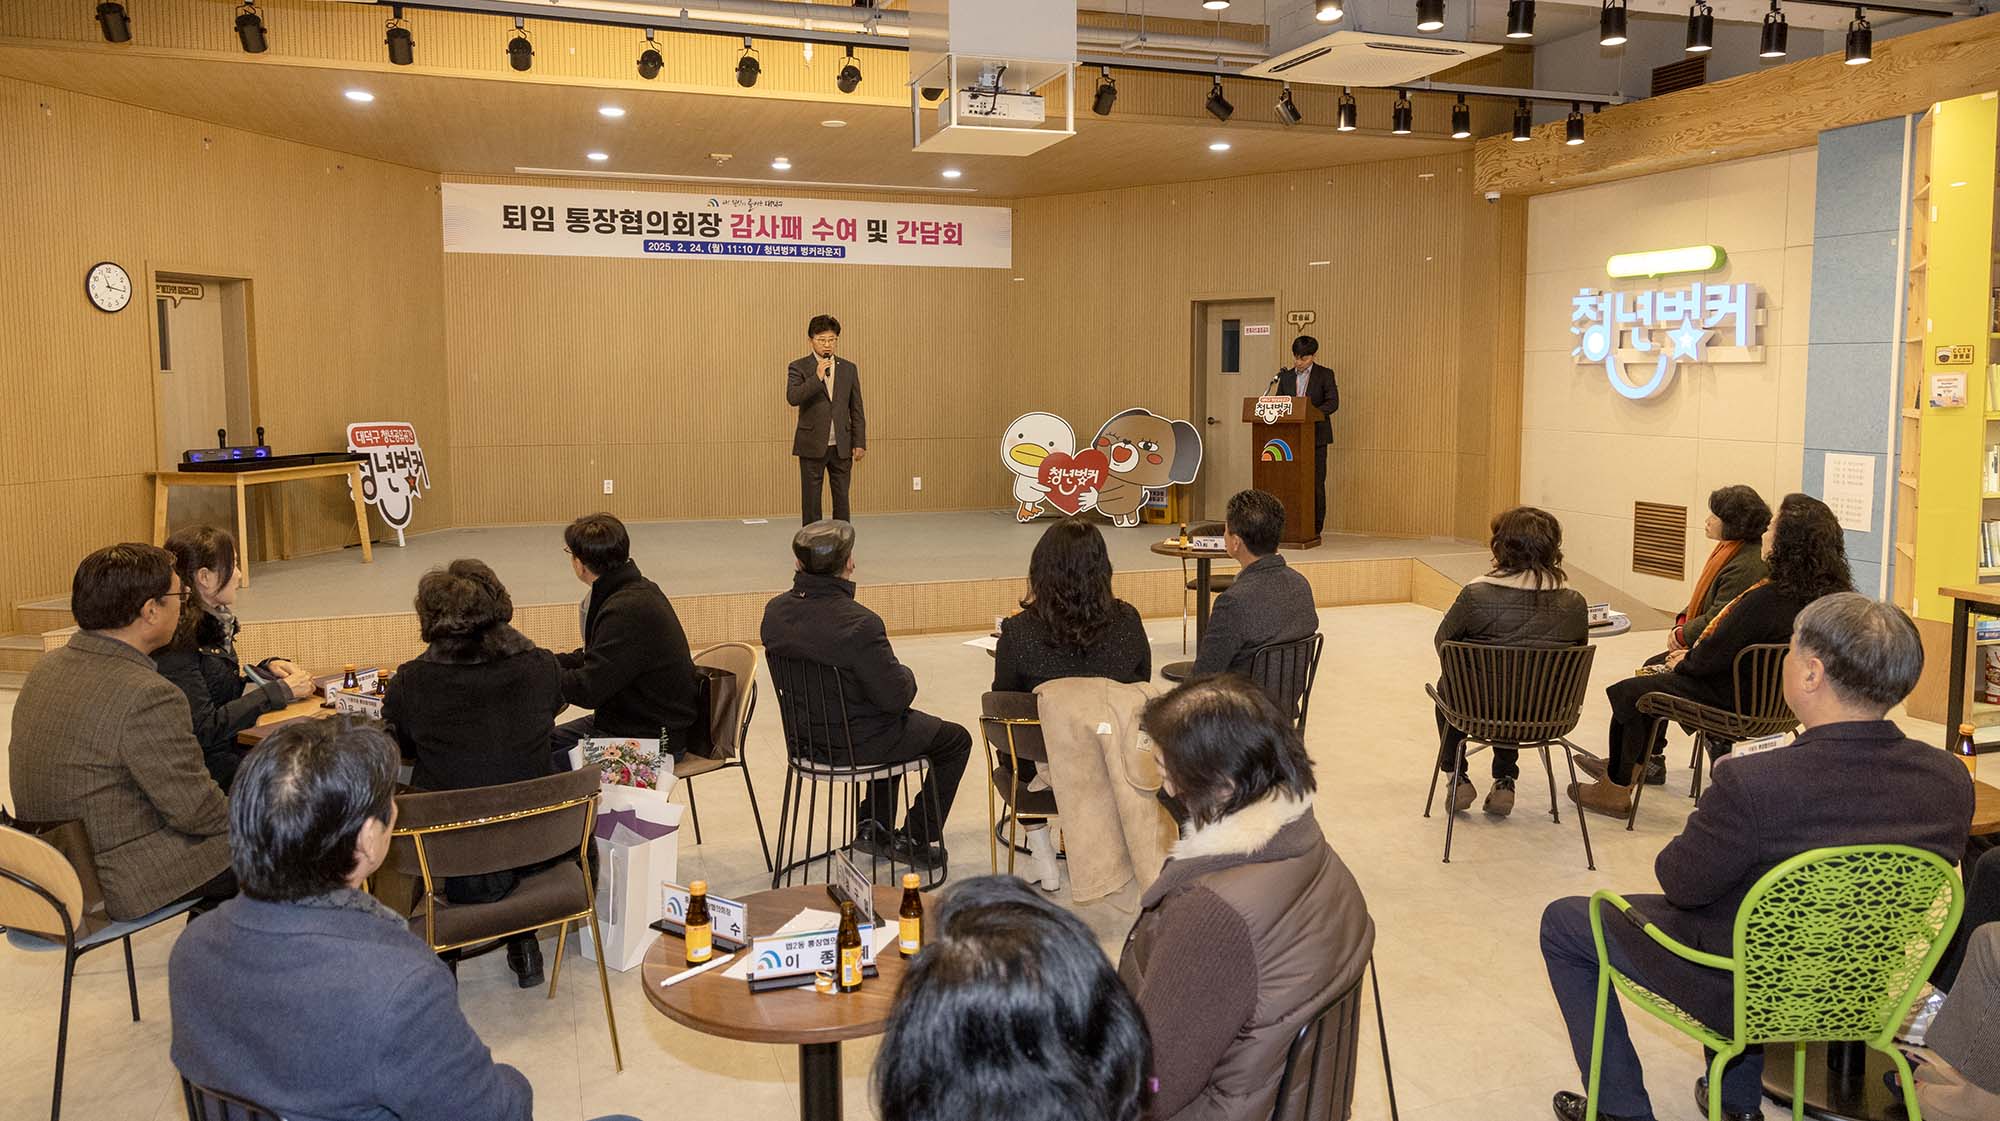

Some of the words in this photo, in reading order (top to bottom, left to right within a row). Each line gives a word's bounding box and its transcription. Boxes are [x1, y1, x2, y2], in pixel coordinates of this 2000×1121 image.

[502, 204, 555, 232] 퇴임
[565, 207, 722, 238] 통장협의회장
[730, 213, 802, 241] 감사패
[812, 217, 857, 242] 수여
[867, 219, 888, 244] 및
[896, 220, 963, 246] 간담회
[648, 242, 674, 252] 2025.
[677, 243, 687, 252] 2.
[689, 243, 705, 253] 24.
[707, 243, 724, 254] (월)
[727, 244, 753, 254] 11:10
[764, 245, 796, 256] 청년벙커
[800, 246, 842, 257] 벙커라운지
[1570, 281, 1747, 362] 청년벙커
[1256, 402, 1292, 416] 청년벙커
[355, 430, 380, 444] 대덕구
[1048, 466, 1099, 486] 청년벙커
[730, 923, 741, 936] 수
[808, 936, 837, 948] 통장협의
